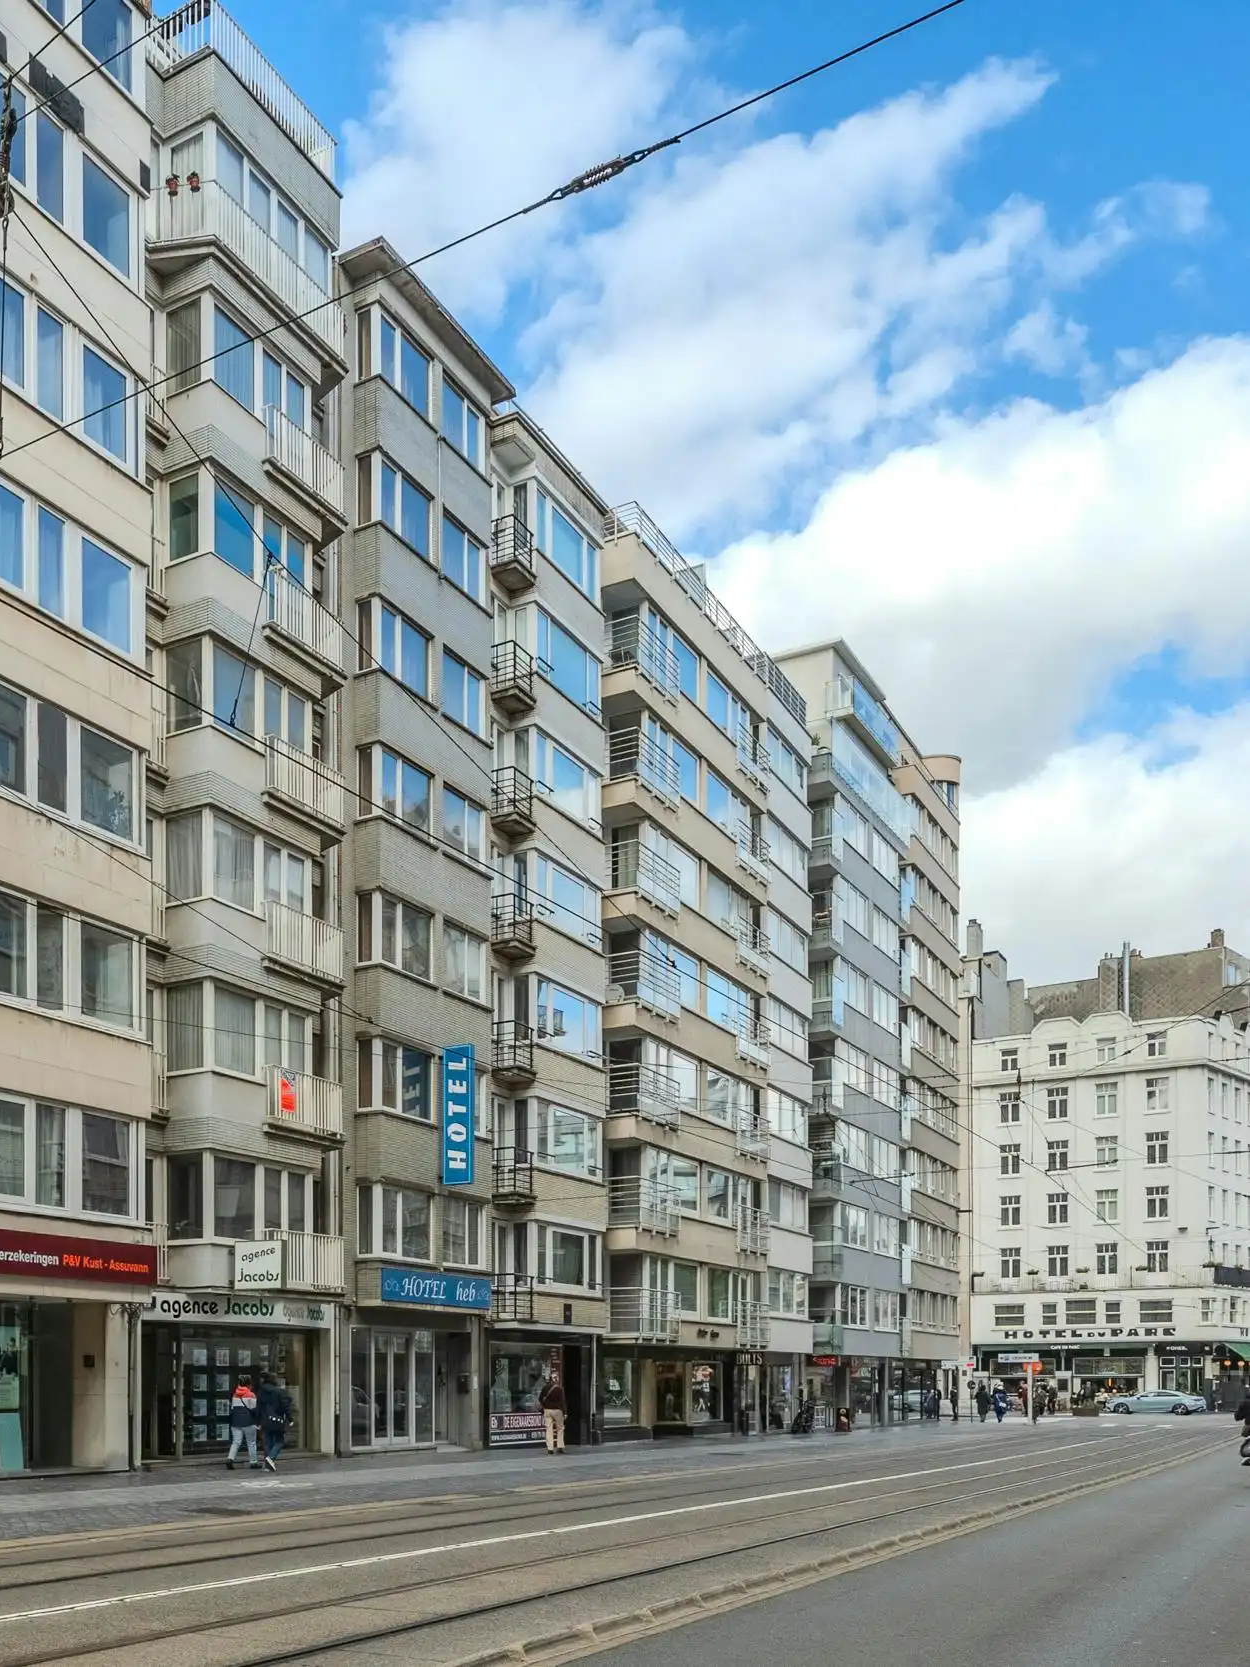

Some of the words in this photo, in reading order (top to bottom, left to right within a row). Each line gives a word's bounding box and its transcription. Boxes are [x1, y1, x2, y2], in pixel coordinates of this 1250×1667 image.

[447, 1057, 467, 1169] HOTEL
[63, 1254, 81, 1268] P&V
[83, 1256, 103, 1269] Kust
[109, 1260, 149, 1273] Assuvann
[241, 1247, 276, 1263] agence
[401, 1276, 447, 1299] HOTEL
[161, 1299, 219, 1318] agence
[224, 1297, 275, 1316] Jacobs
[1004, 1329, 1083, 1339] HOTEL
[1111, 1327, 1176, 1337] PARC
